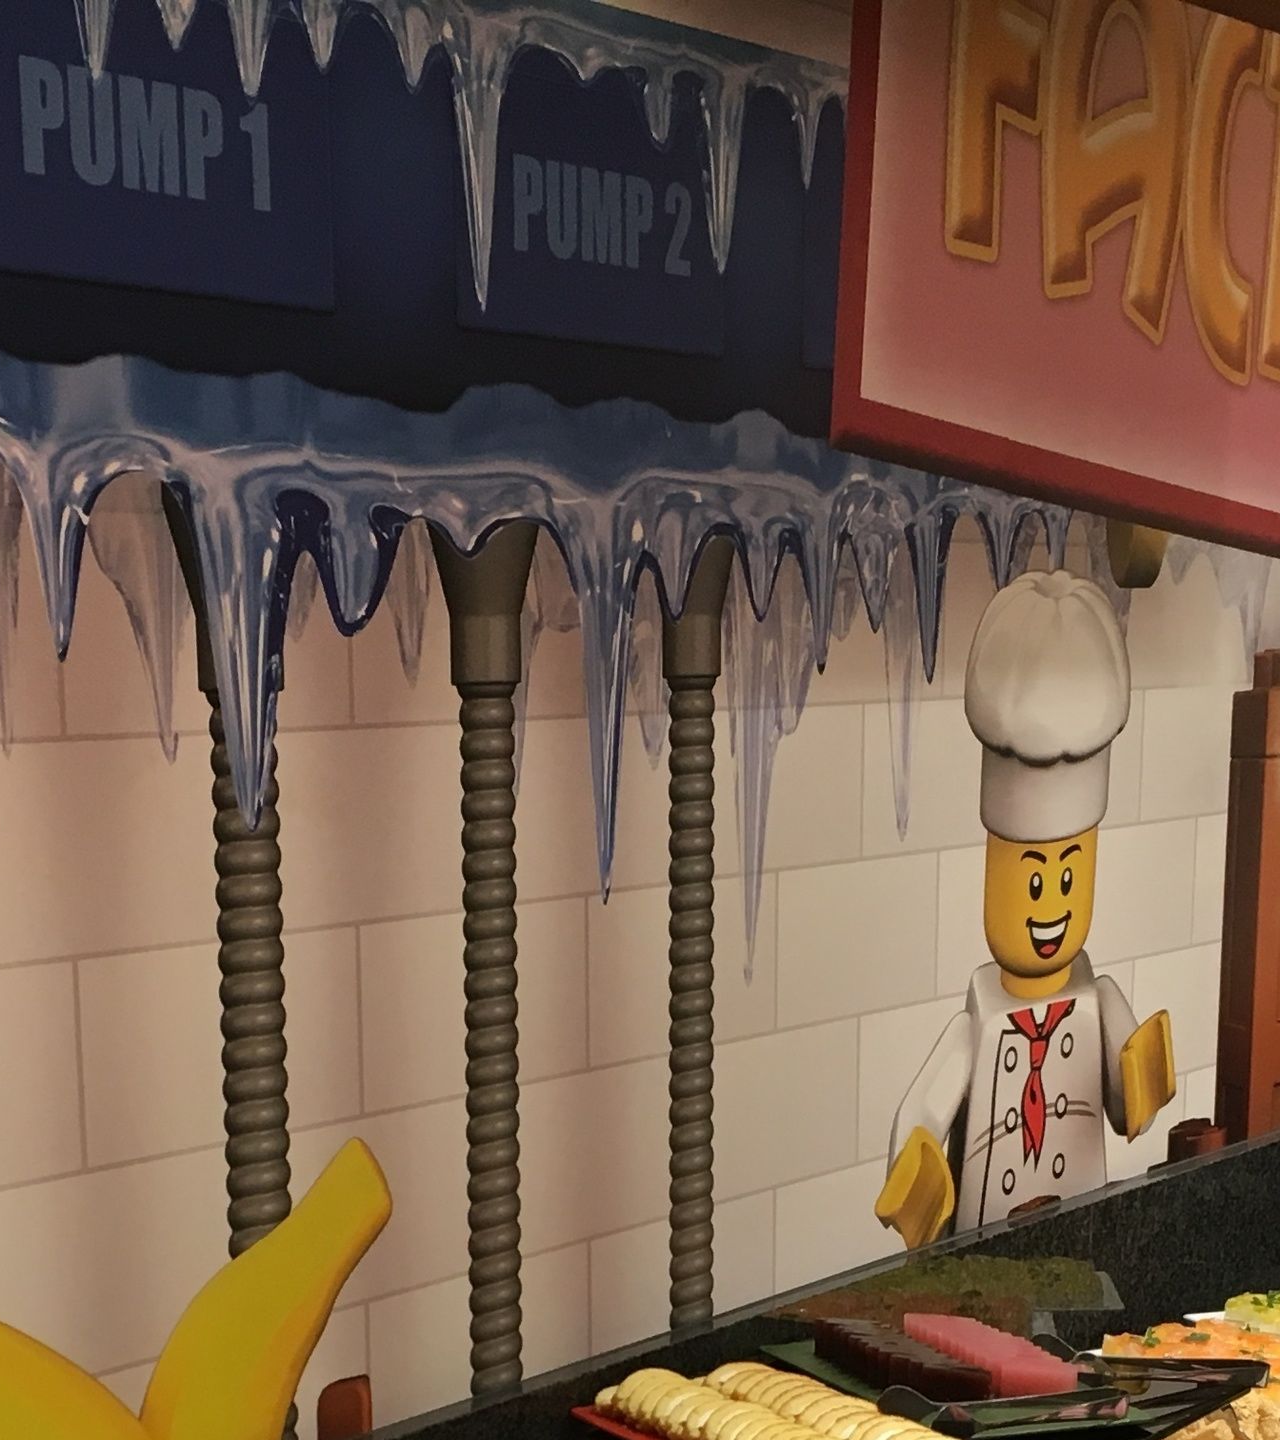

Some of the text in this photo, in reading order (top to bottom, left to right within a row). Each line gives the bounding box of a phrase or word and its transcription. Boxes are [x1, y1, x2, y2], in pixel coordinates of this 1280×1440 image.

[18, 54, 271, 212] PUMP 1
[513, 153, 692, 278] PUMP 2
